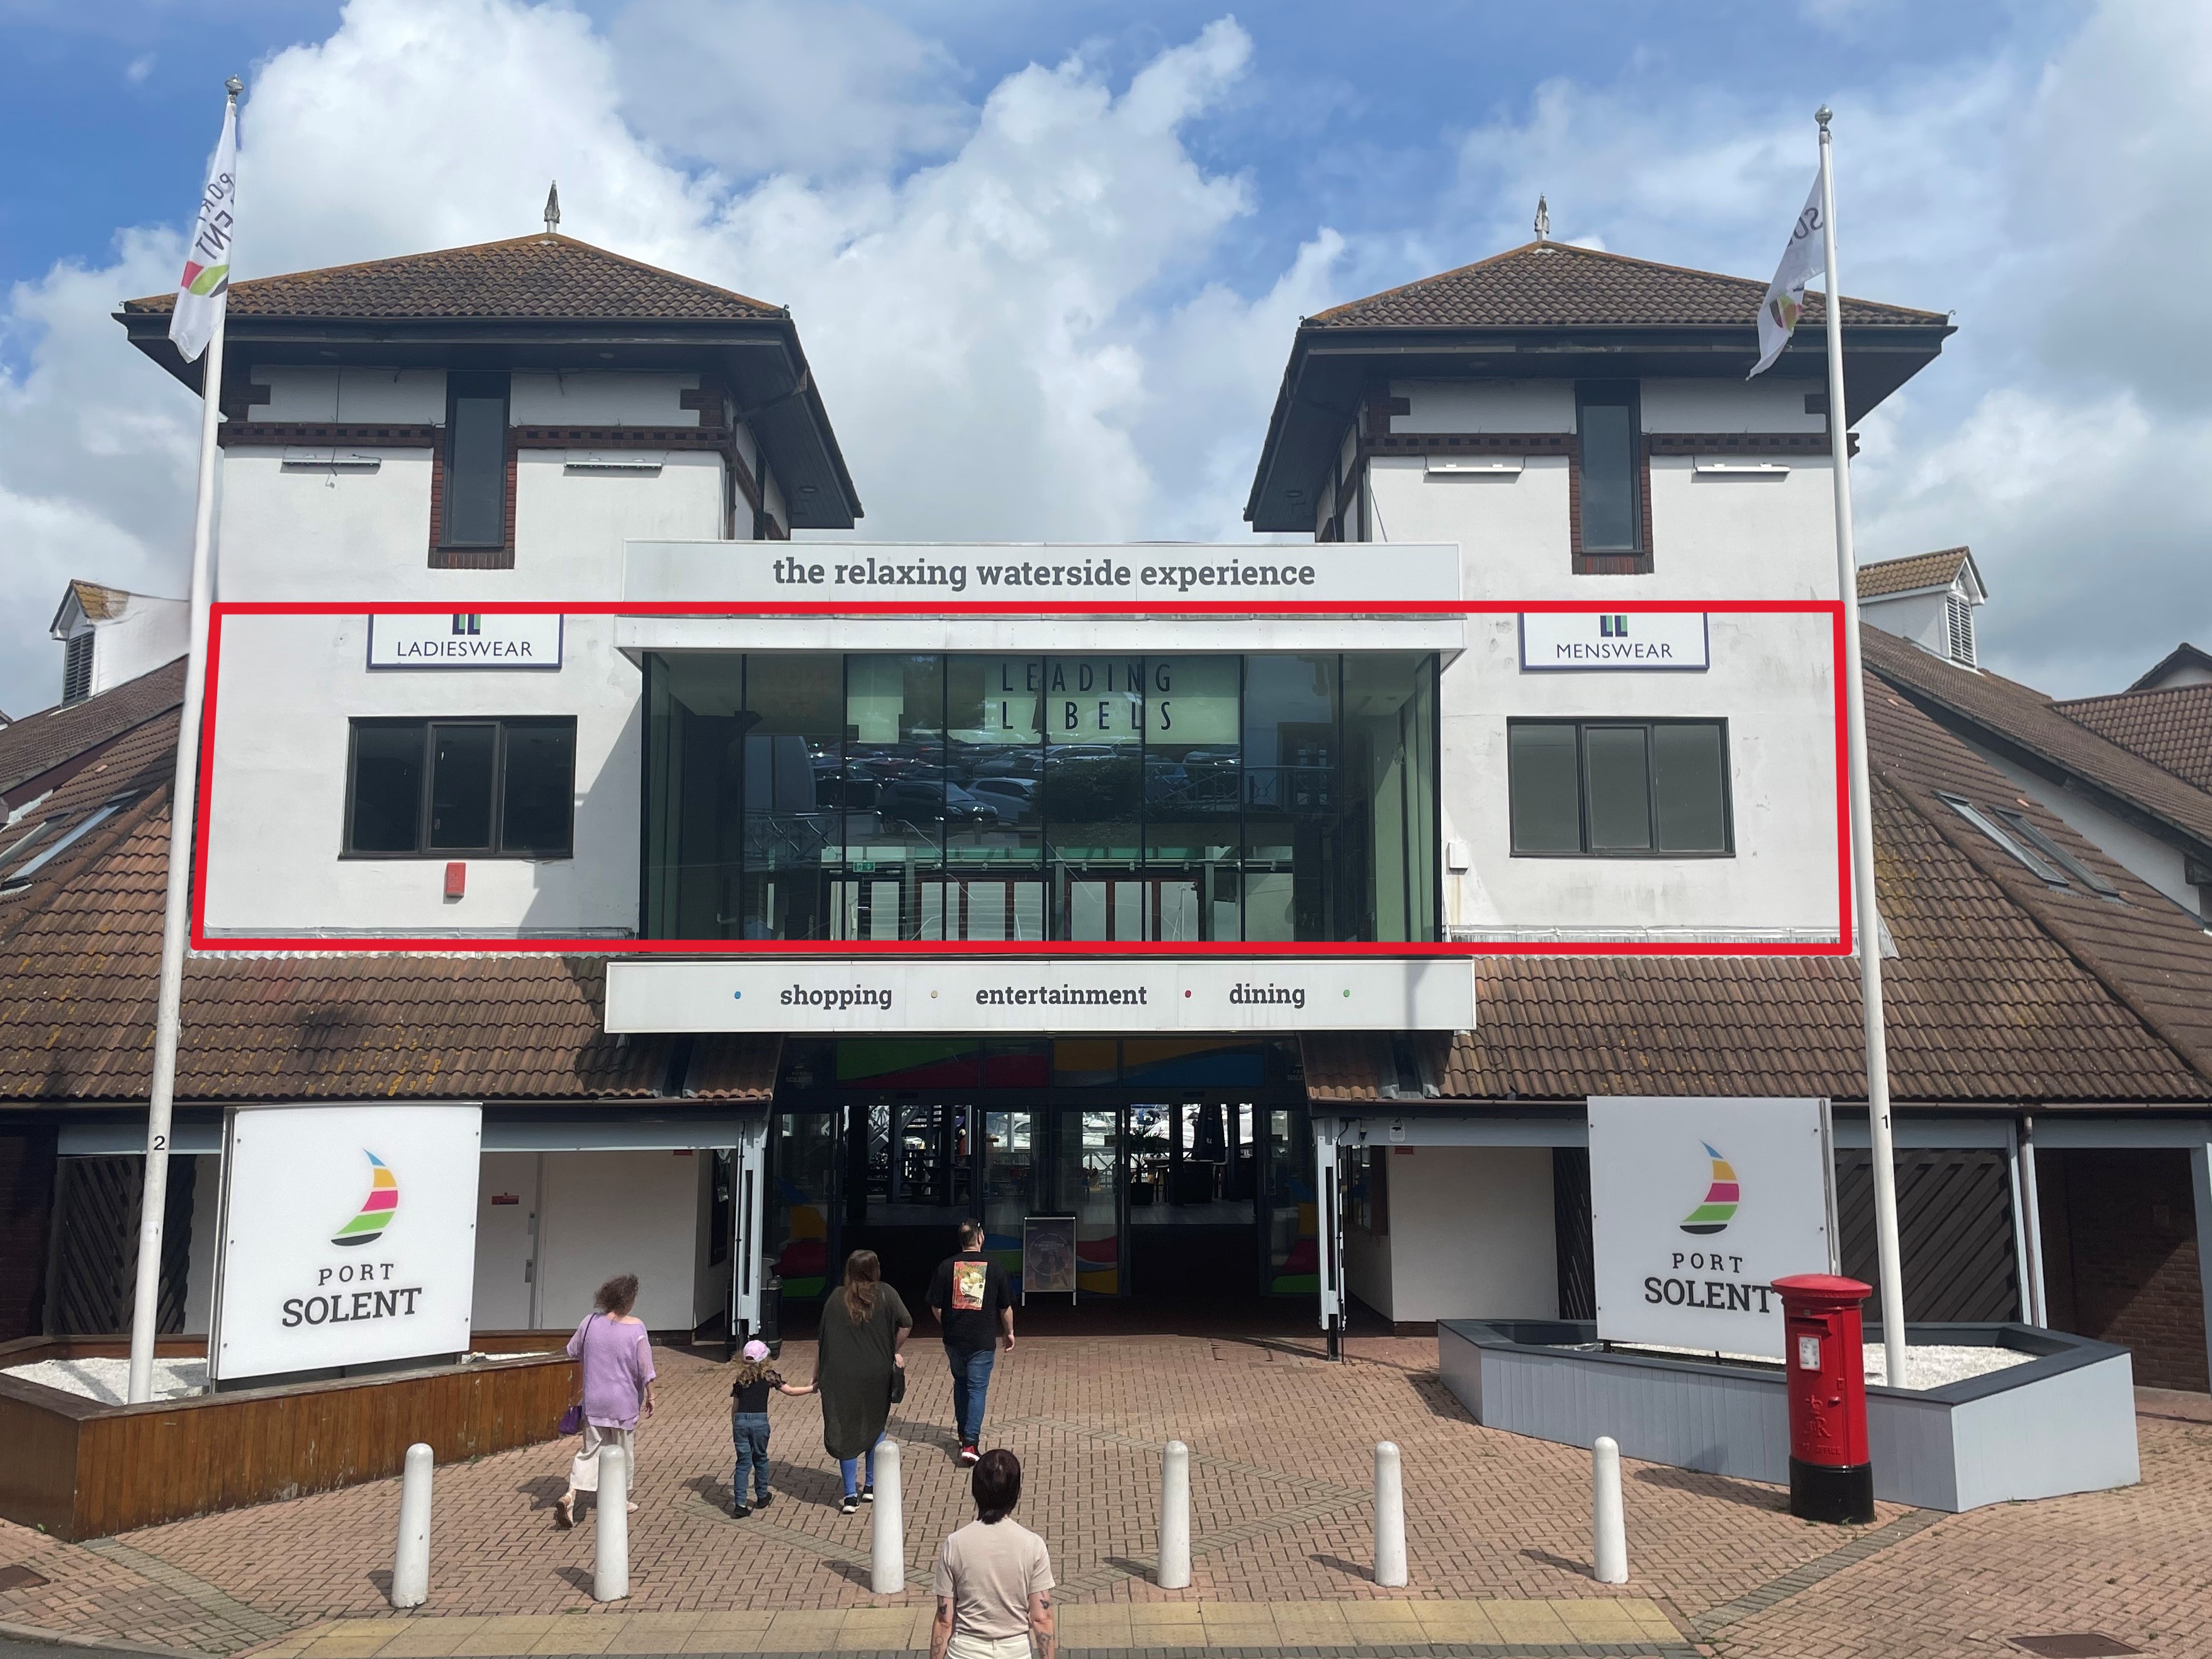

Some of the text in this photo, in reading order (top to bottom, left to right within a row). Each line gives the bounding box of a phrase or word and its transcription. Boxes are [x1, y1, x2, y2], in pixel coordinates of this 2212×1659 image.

[773, 557, 1315, 592] the relaxing waterside experience
[397, 641, 532, 656] LADIESWEAR
[1556, 643, 1673, 658] MENSWEAR
[1002, 663, 1171, 692] LEADING
[1002, 701, 1171, 730] LBELS
[780, 984, 892, 1009] shopping
[976, 984, 1147, 1005] entertainment
[1230, 983, 1305, 1009] dining
[1881, 1115, 1889, 1129] 1
[153, 1135, 166, 1150] 2
[318, 1263, 394, 1286] PORT
[1671, 1252, 1743, 1273] PORT
[282, 1287, 422, 1327] SOLENT
[1644, 1277, 1774, 1313] SOLENT
